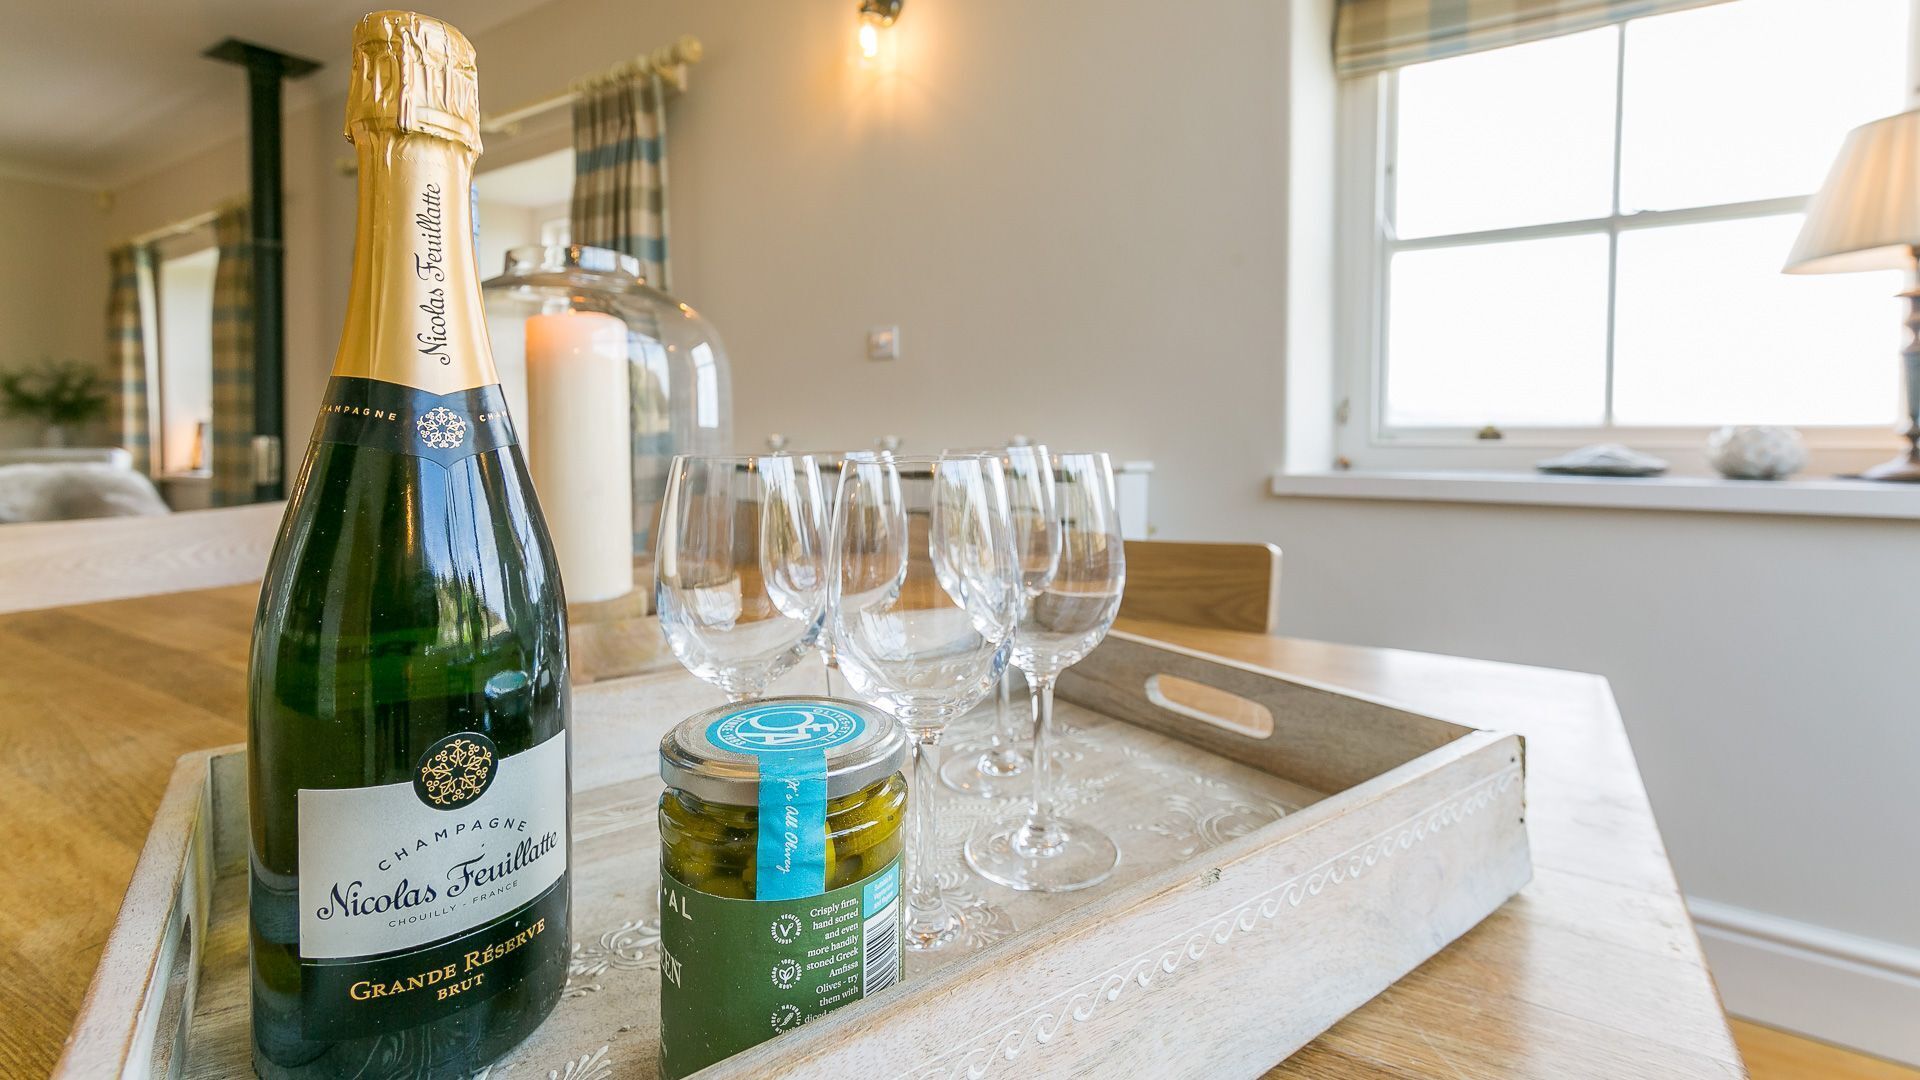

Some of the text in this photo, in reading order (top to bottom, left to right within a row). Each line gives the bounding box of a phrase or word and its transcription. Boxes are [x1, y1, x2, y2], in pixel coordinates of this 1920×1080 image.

[413, 182, 450, 366] Nicolas Feuillatte
[776, 778, 800, 802] It's
[378, 817, 527, 871] CHAMPAGNE
[776, 831, 799, 874] Olivey
[316, 831, 559, 921] Nicolas Feuillatte
[389, 905, 456, 928] CHOUILLY
[473, 880, 519, 904] FRANCE
[810, 898, 859, 917] Crisply firm,
[813, 908, 859, 930] hand sorted
[825, 923, 858, 940] and even
[808, 935, 859, 957] more handily
[350, 918, 546, 1000] GRANDE RÉSERVE
[807, 947, 858, 970] stoned Greek
[829, 961, 859, 977] Amfissa
[438, 972, 485, 1001] BRUT
[816, 981, 842, 994] Olives
[848, 973, 859, 984] try
[820, 985, 859, 1007] them with
